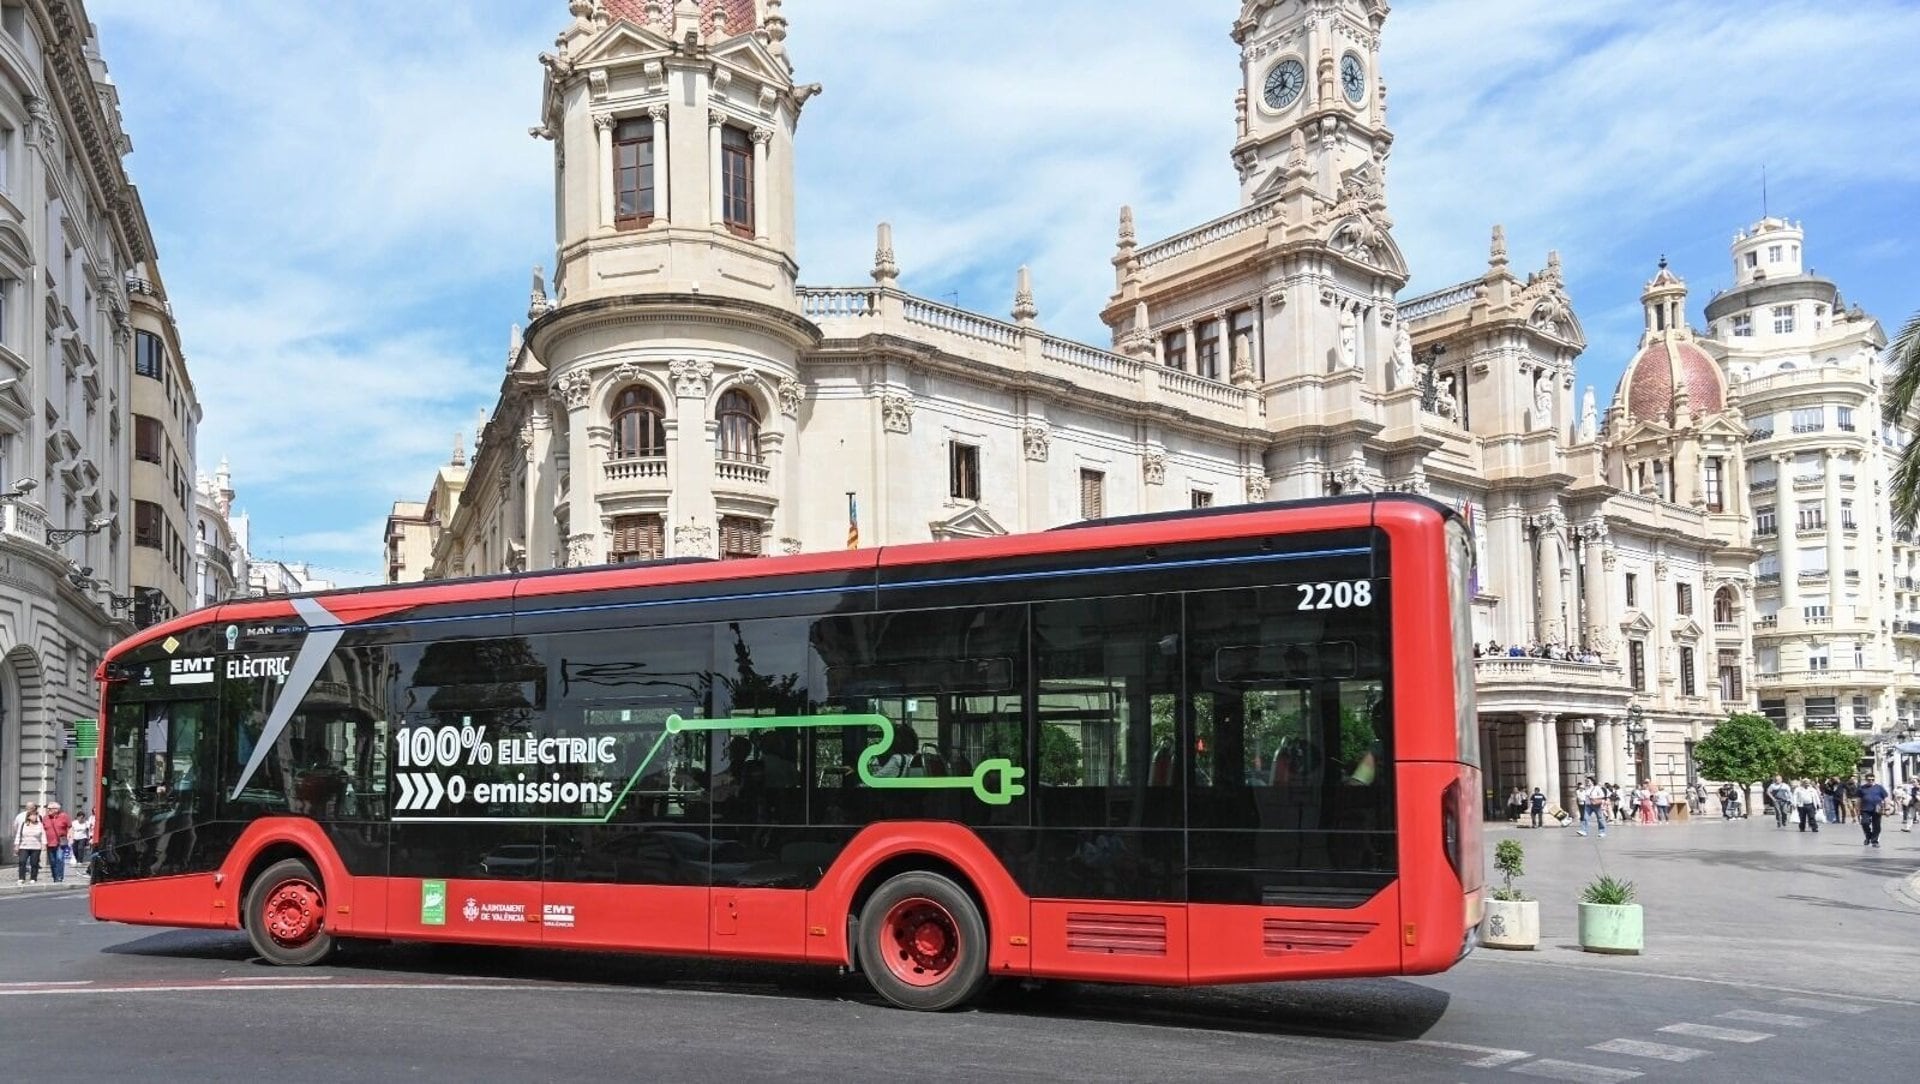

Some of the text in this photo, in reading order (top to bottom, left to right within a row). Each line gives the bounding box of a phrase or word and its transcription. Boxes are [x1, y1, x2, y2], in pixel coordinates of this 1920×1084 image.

[1297, 580, 1372, 610] 2208
[247, 626, 274, 637] MAN
[170, 657, 215, 673] EMT
[226, 655, 290, 679] ELÈCTRIC
[396, 725, 617, 767] 100% ELÈCTRIC
[447, 772, 613, 803] 0 emissions
[481, 903, 526, 913] AJUNTAMENT
[543, 904, 575, 914] EMT
[480, 912, 491, 921] DE
